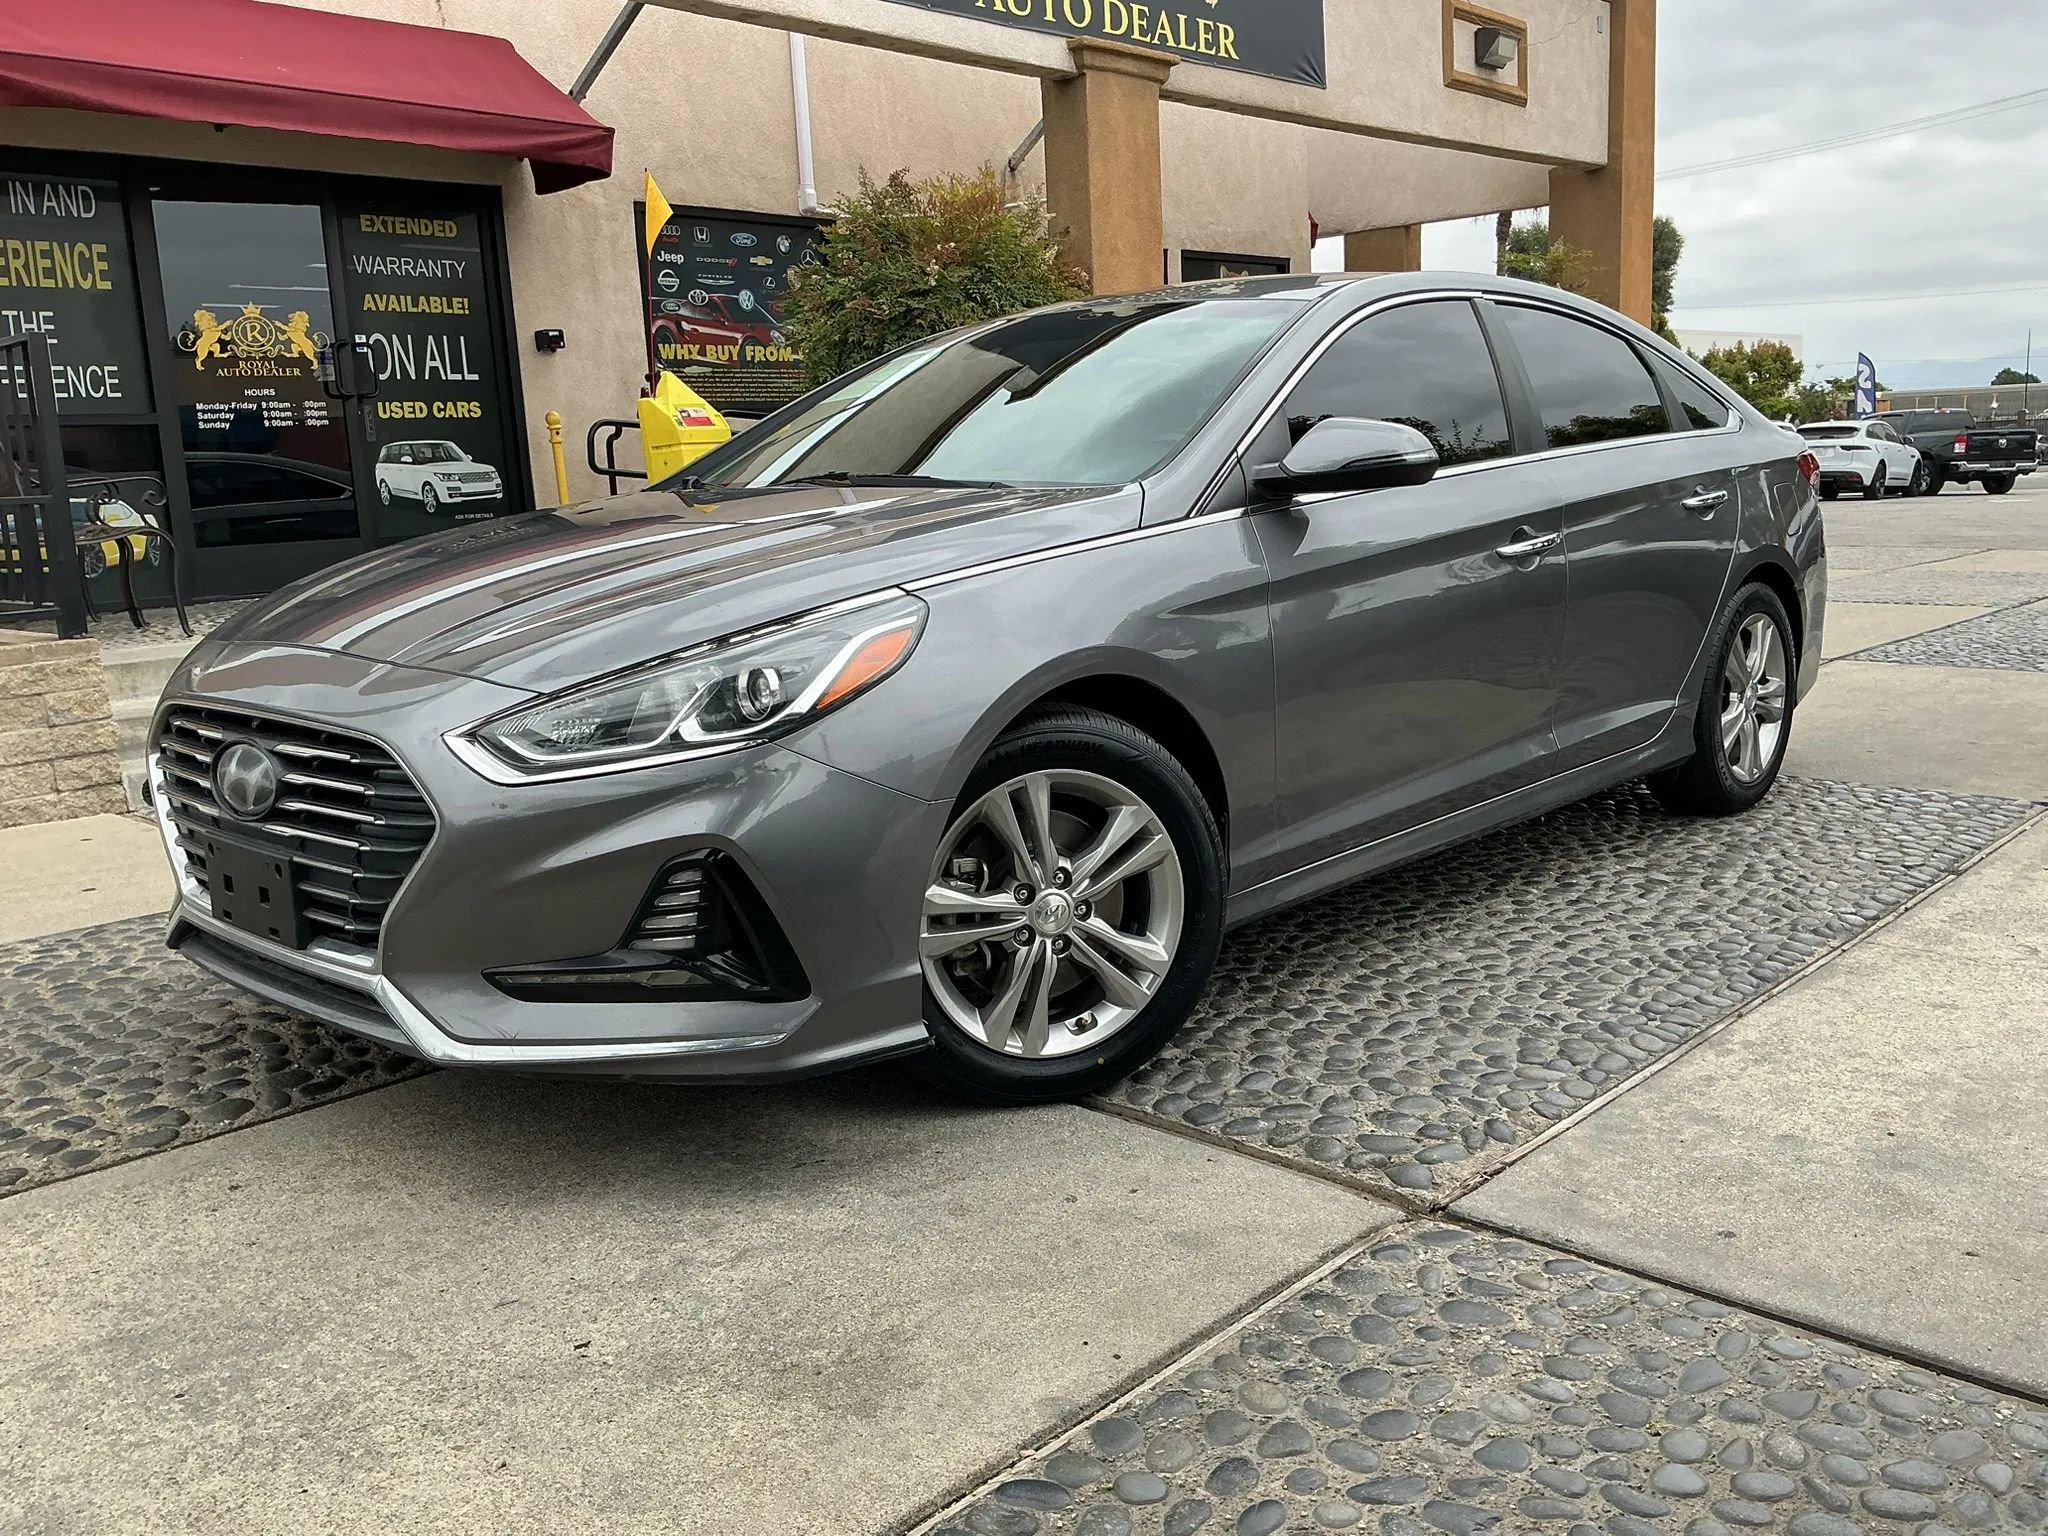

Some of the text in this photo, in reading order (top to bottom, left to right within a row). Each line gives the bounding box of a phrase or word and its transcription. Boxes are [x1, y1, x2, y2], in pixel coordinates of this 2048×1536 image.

[975, 0, 1240, 60] TO DEALER
[8, 180, 96, 218] IN AND
[360, 214, 458, 238] EXTENDED
[352, 254, 466, 279] WARRANTY
[657, 250, 685, 265] Jeep
[363, 293, 470, 315] AVAILABLE!
[1, 310, 58, 344] THE
[367, 332, 479, 380] ON ALL
[658, 343, 701, 361] WHY
[706, 345, 740, 361] BUY
[745, 345, 794, 362] FROM
[216, 368, 302, 377] AUTO DEALER
[238, 360, 279, 369] ROYAL
[244, 388, 276, 397] HOURS
[196, 401, 257, 411] Monday-Friday
[261, 401, 291, 409] 9:00am
[377, 401, 482, 419] USED CARS
[197, 412, 235, 421] Saturday
[262, 410, 292, 418] 9:00am
[198, 421, 230, 430] Sunday
[264, 419, 294, 427] 9:00am
